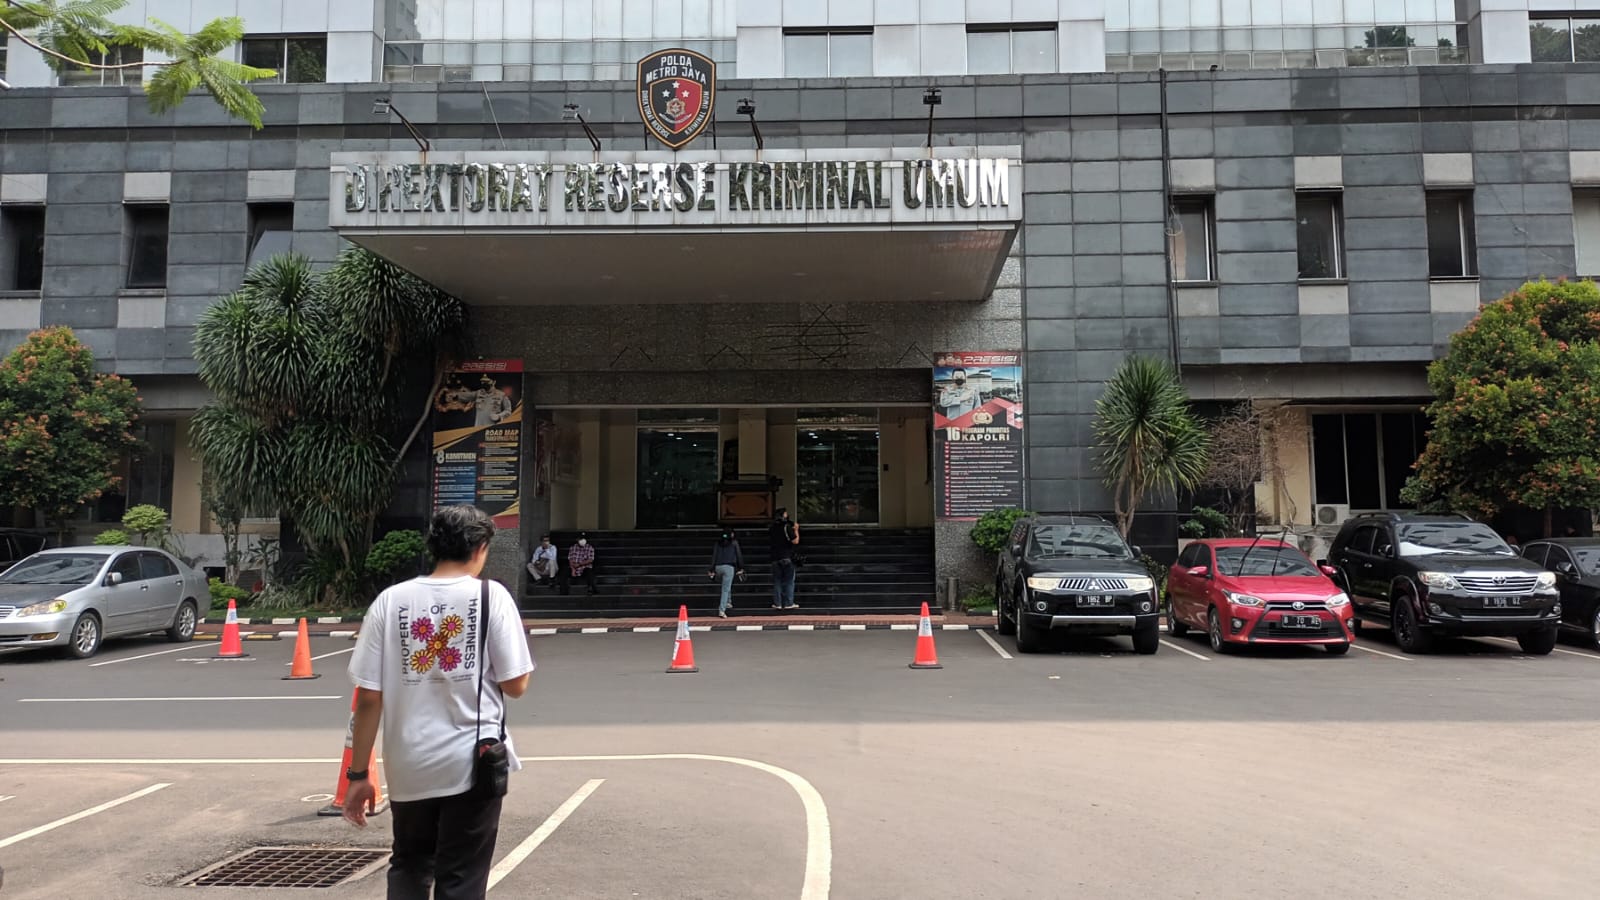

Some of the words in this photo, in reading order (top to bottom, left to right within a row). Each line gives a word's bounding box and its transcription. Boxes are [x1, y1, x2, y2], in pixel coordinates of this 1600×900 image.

[660, 55, 692, 67] POLDA
[645, 66, 677, 84] METRO
[681, 66, 706, 84] JAYA
[345, 163, 552, 213] DIREKTORAT
[564, 162, 715, 213] RESERSE
[729, 160, 890, 211] KRIMINAL
[903, 158, 1008, 209] UMUM
[462, 362, 507, 370] PRESISI
[963, 355, 1017, 364] PRESISI
[946, 427, 960, 441] 16
[437, 450, 444, 464] 8
[430, 604, 448, 615] OF
[399, 606, 410, 675] PROPERTY
[464, 598, 479, 670] HAPPINESS
